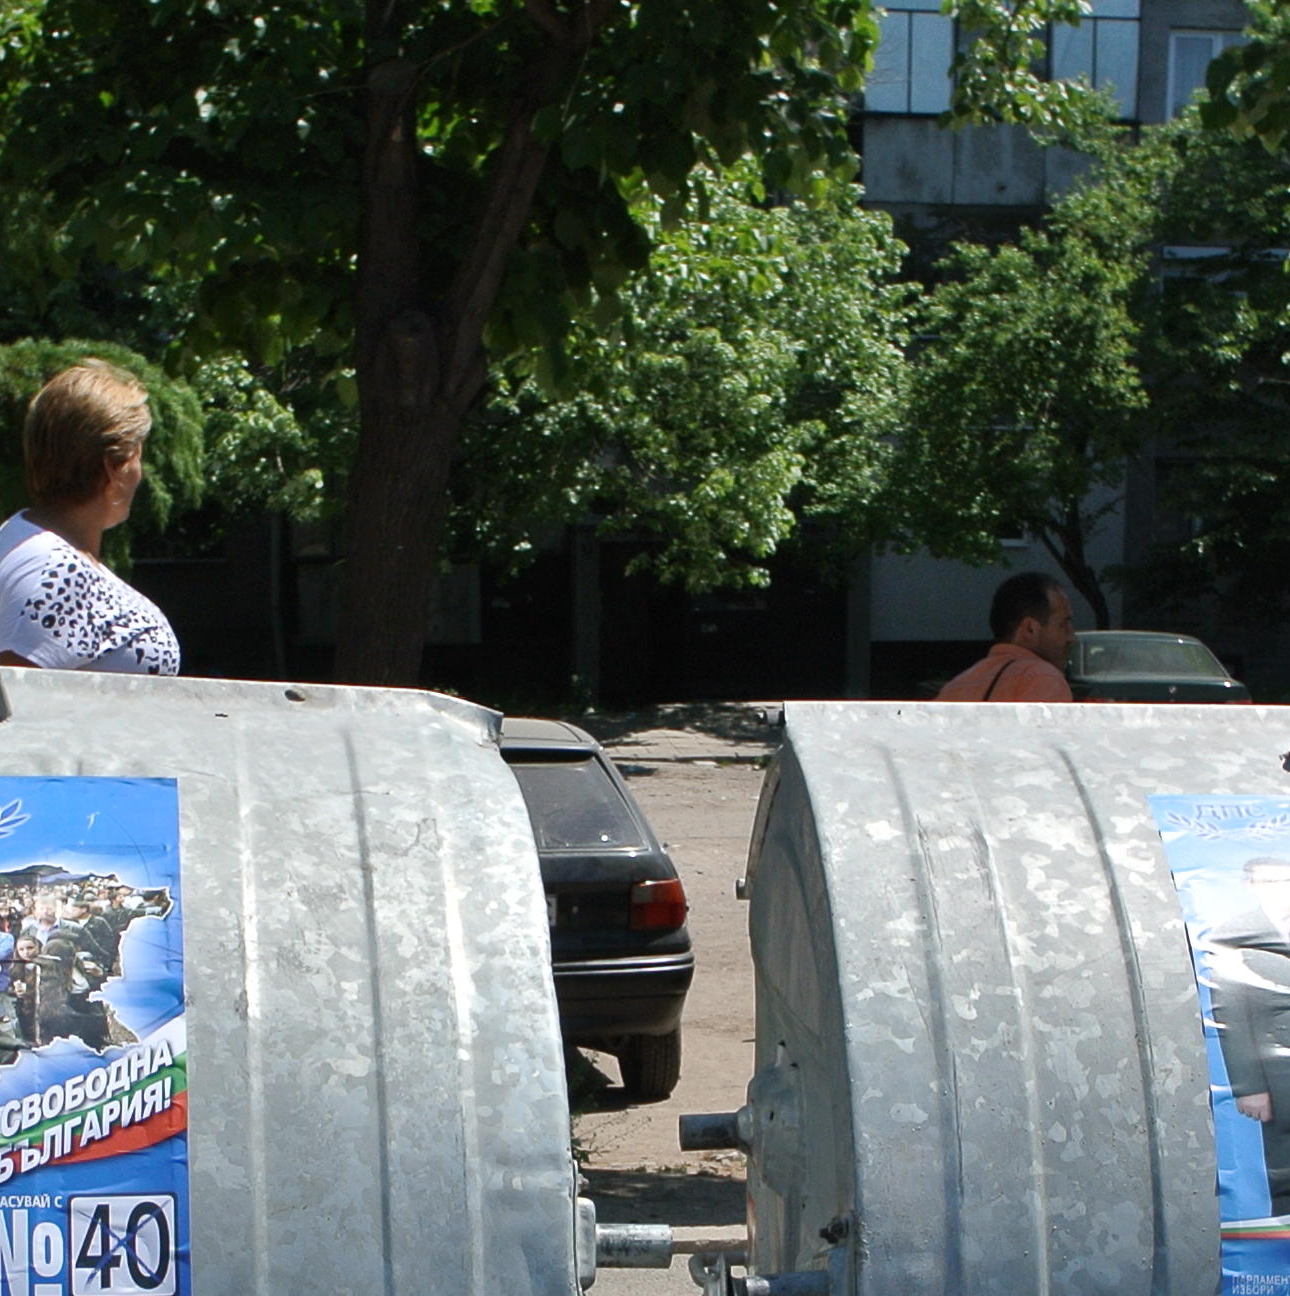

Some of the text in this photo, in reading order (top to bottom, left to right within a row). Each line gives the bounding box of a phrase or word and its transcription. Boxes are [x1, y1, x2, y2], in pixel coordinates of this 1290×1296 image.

[1193, 801, 1266, 820] ДПС
[0, 1037, 173, 1138] СВОБОДНА
[54, 1195, 63, 1209] С
[73, 1202, 169, 1291] 40
[1232, 1285, 1274, 1296] ИЗБОРИ
